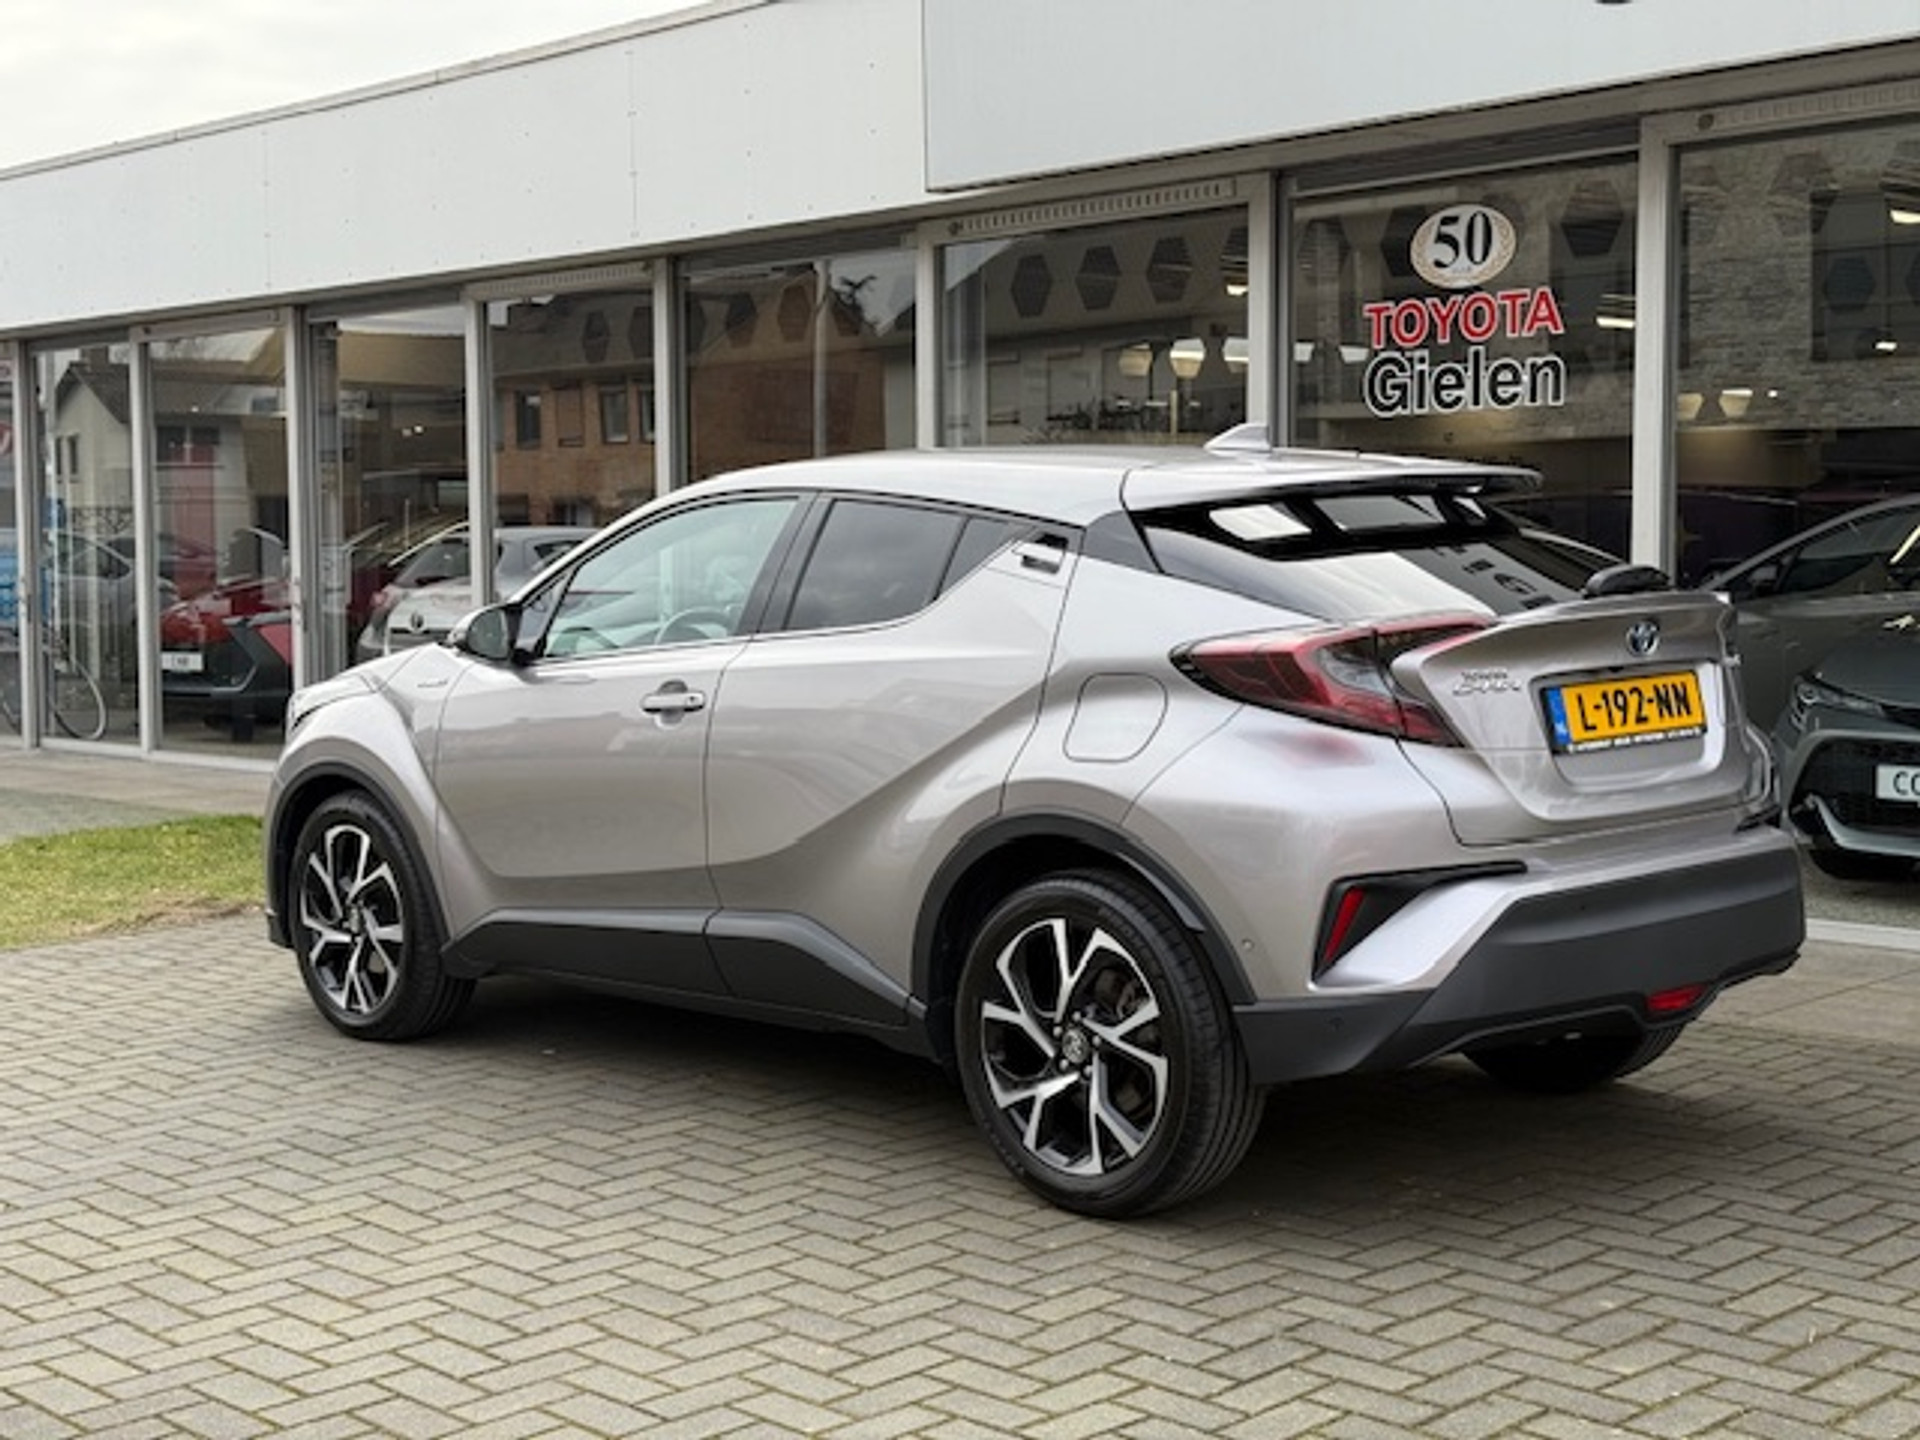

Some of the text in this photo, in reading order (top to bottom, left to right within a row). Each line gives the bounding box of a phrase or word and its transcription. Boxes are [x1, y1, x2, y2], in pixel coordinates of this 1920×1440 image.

[1433, 211, 1492, 268] 50
[1364, 287, 1564, 348] TOYOTA
[1364, 346, 1565, 417] Gielen
[1577, 682, 1692, 731] L-192-NN
